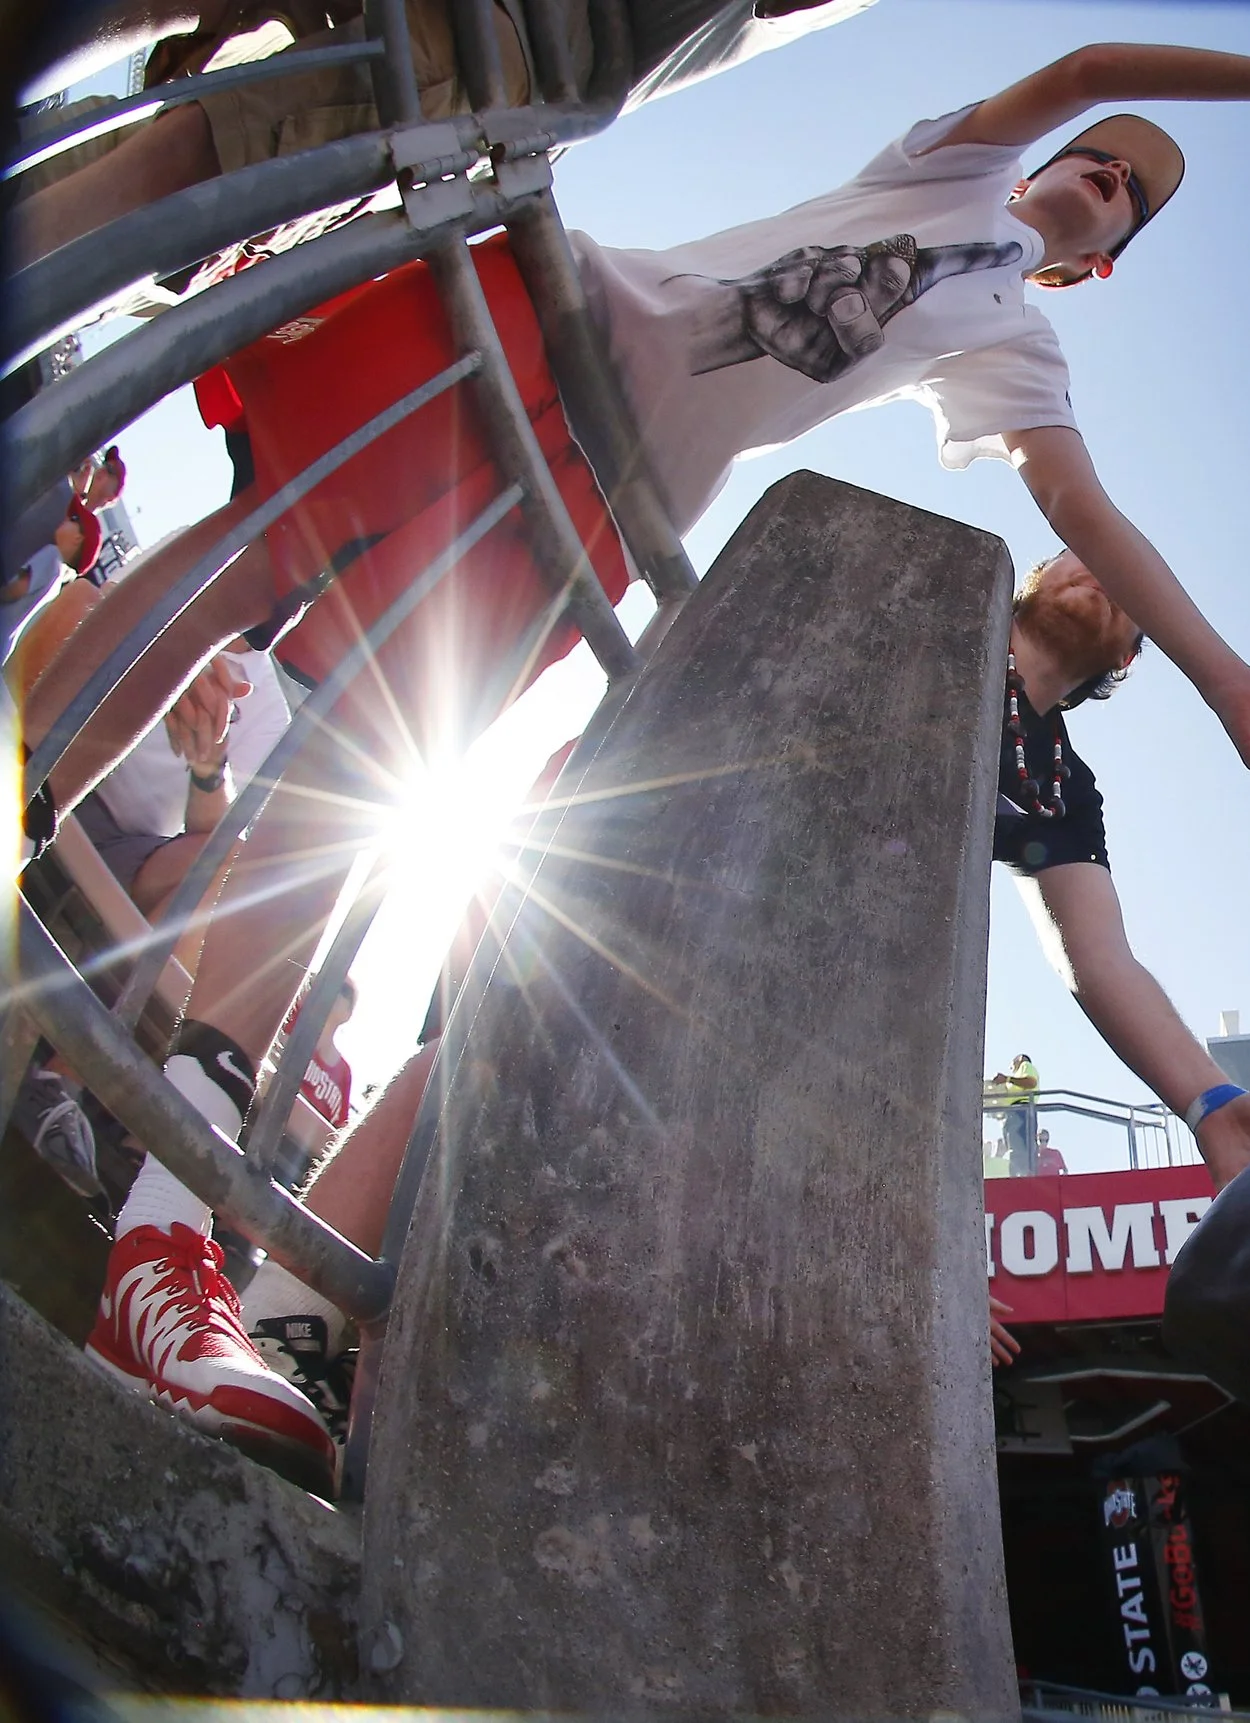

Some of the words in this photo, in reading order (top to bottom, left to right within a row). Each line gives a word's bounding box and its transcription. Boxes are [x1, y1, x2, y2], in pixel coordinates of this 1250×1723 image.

[984, 1196, 1213, 1278] OME
[286, 1322, 312, 1339] NIKE
[1113, 1542, 1156, 1675] STATE
